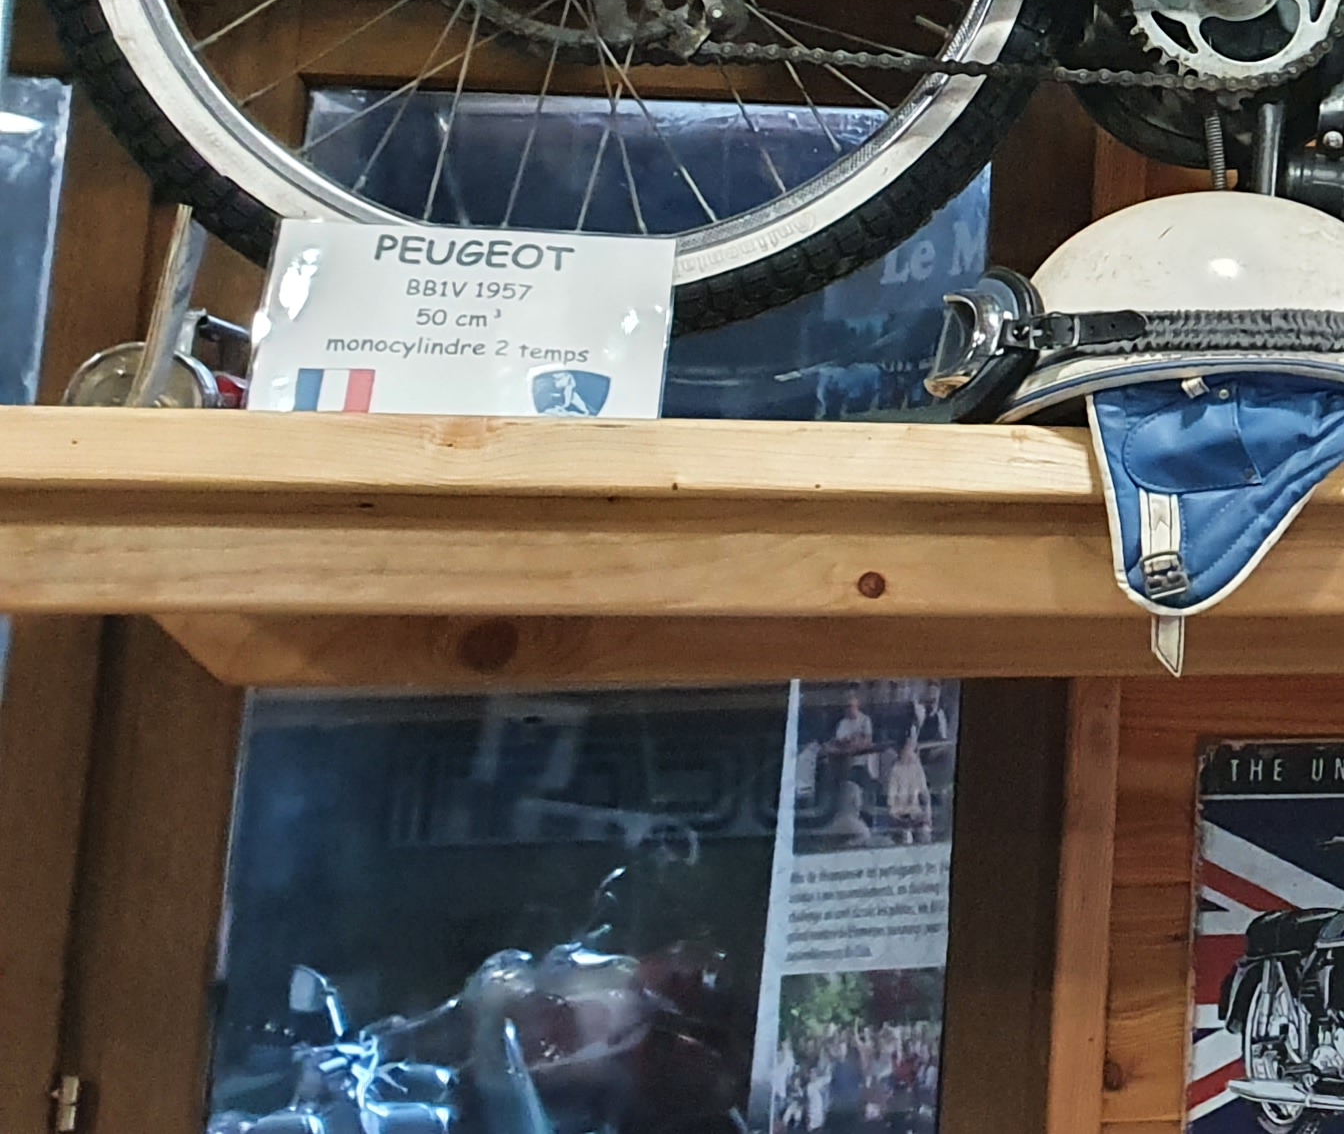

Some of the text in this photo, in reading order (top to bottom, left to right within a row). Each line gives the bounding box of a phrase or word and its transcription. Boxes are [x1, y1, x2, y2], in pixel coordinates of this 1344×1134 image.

[374, 234, 575, 271] PEUGEOT
[405, 278, 534, 302] BB1V 1957
[415, 307, 448, 328] 50
[325, 335, 590, 365] monocylindre 2 temps
[1229, 757, 1284, 783] THE
